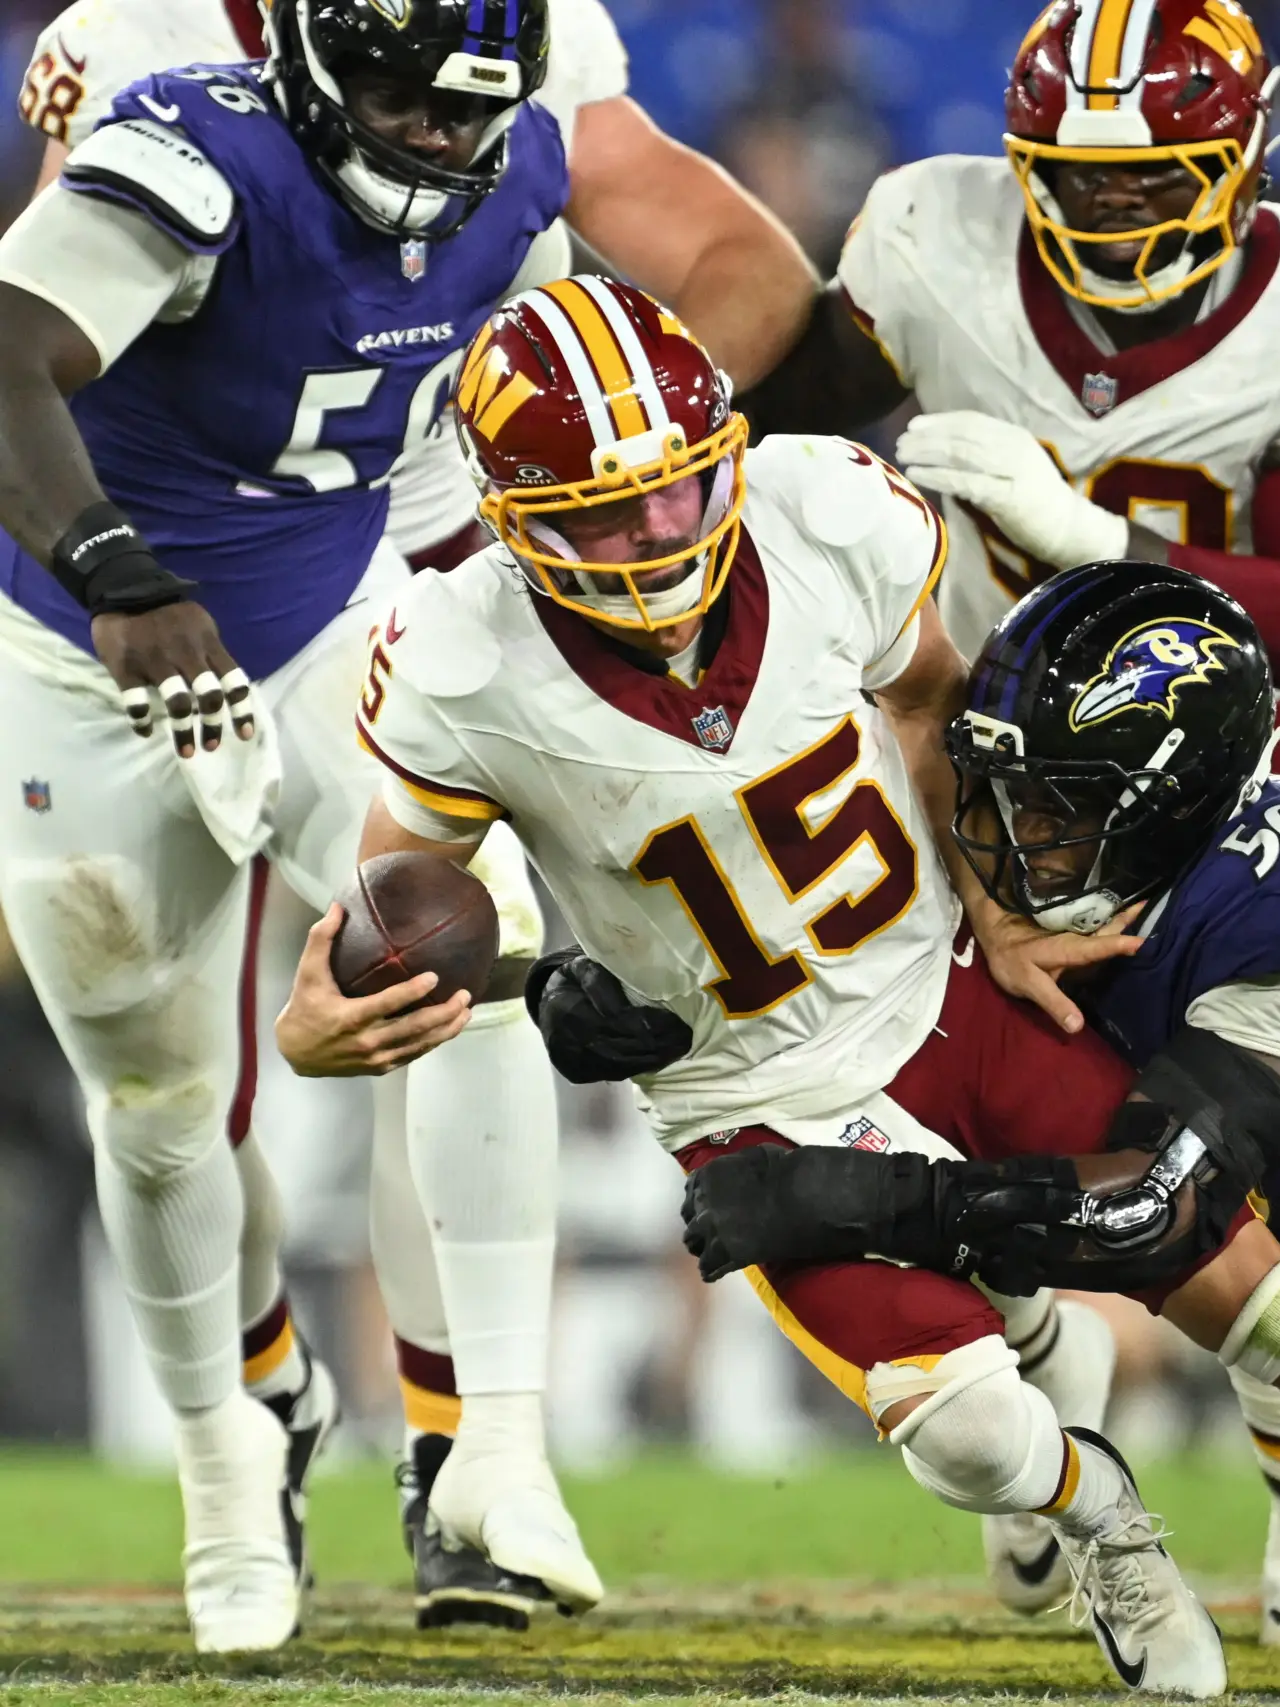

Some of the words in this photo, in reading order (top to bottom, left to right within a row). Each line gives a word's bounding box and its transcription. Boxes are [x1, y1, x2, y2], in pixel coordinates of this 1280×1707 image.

[355, 321, 455, 354] RAVENS
[514, 477, 551, 485] OAKLEY
[71, 524, 135, 561] MUELLER
[361, 624, 394, 726] 5
[703, 720, 729, 743] NFL
[629, 712, 920, 1021] 15
[853, 1129, 887, 1153] NFL
